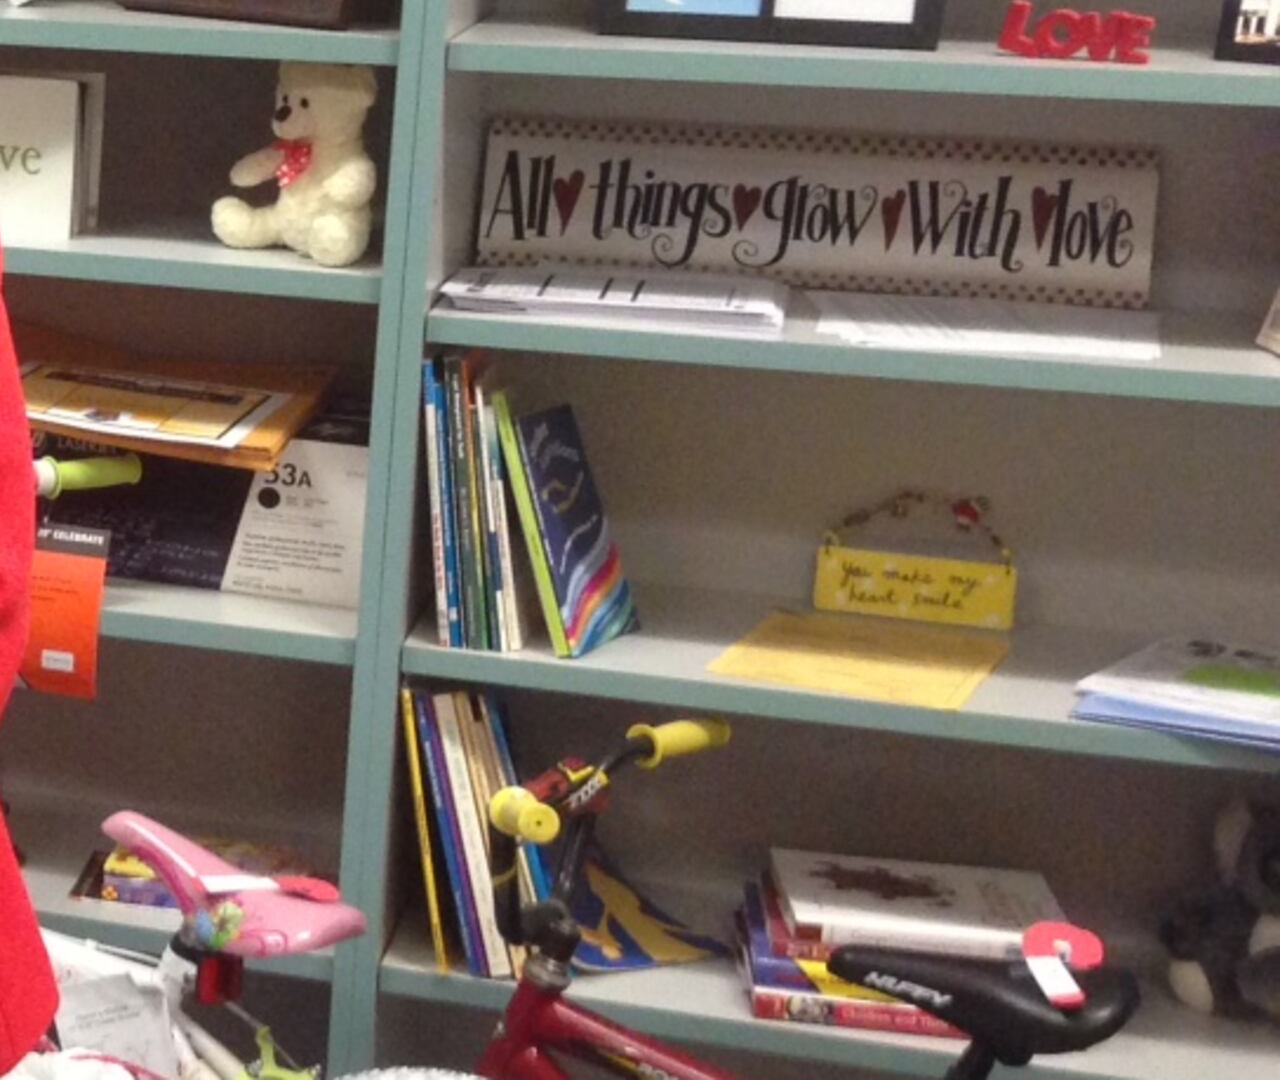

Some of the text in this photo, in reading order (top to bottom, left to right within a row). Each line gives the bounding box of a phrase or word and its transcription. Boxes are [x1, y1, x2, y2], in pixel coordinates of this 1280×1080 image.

[997, 0, 1156, 64] LOVE
[486, 149, 1134, 273] All things grow With love
[849, 582, 962, 609] heart smile
[947, 574, 982, 597] my
[863, 969, 953, 1010] HUFFY
